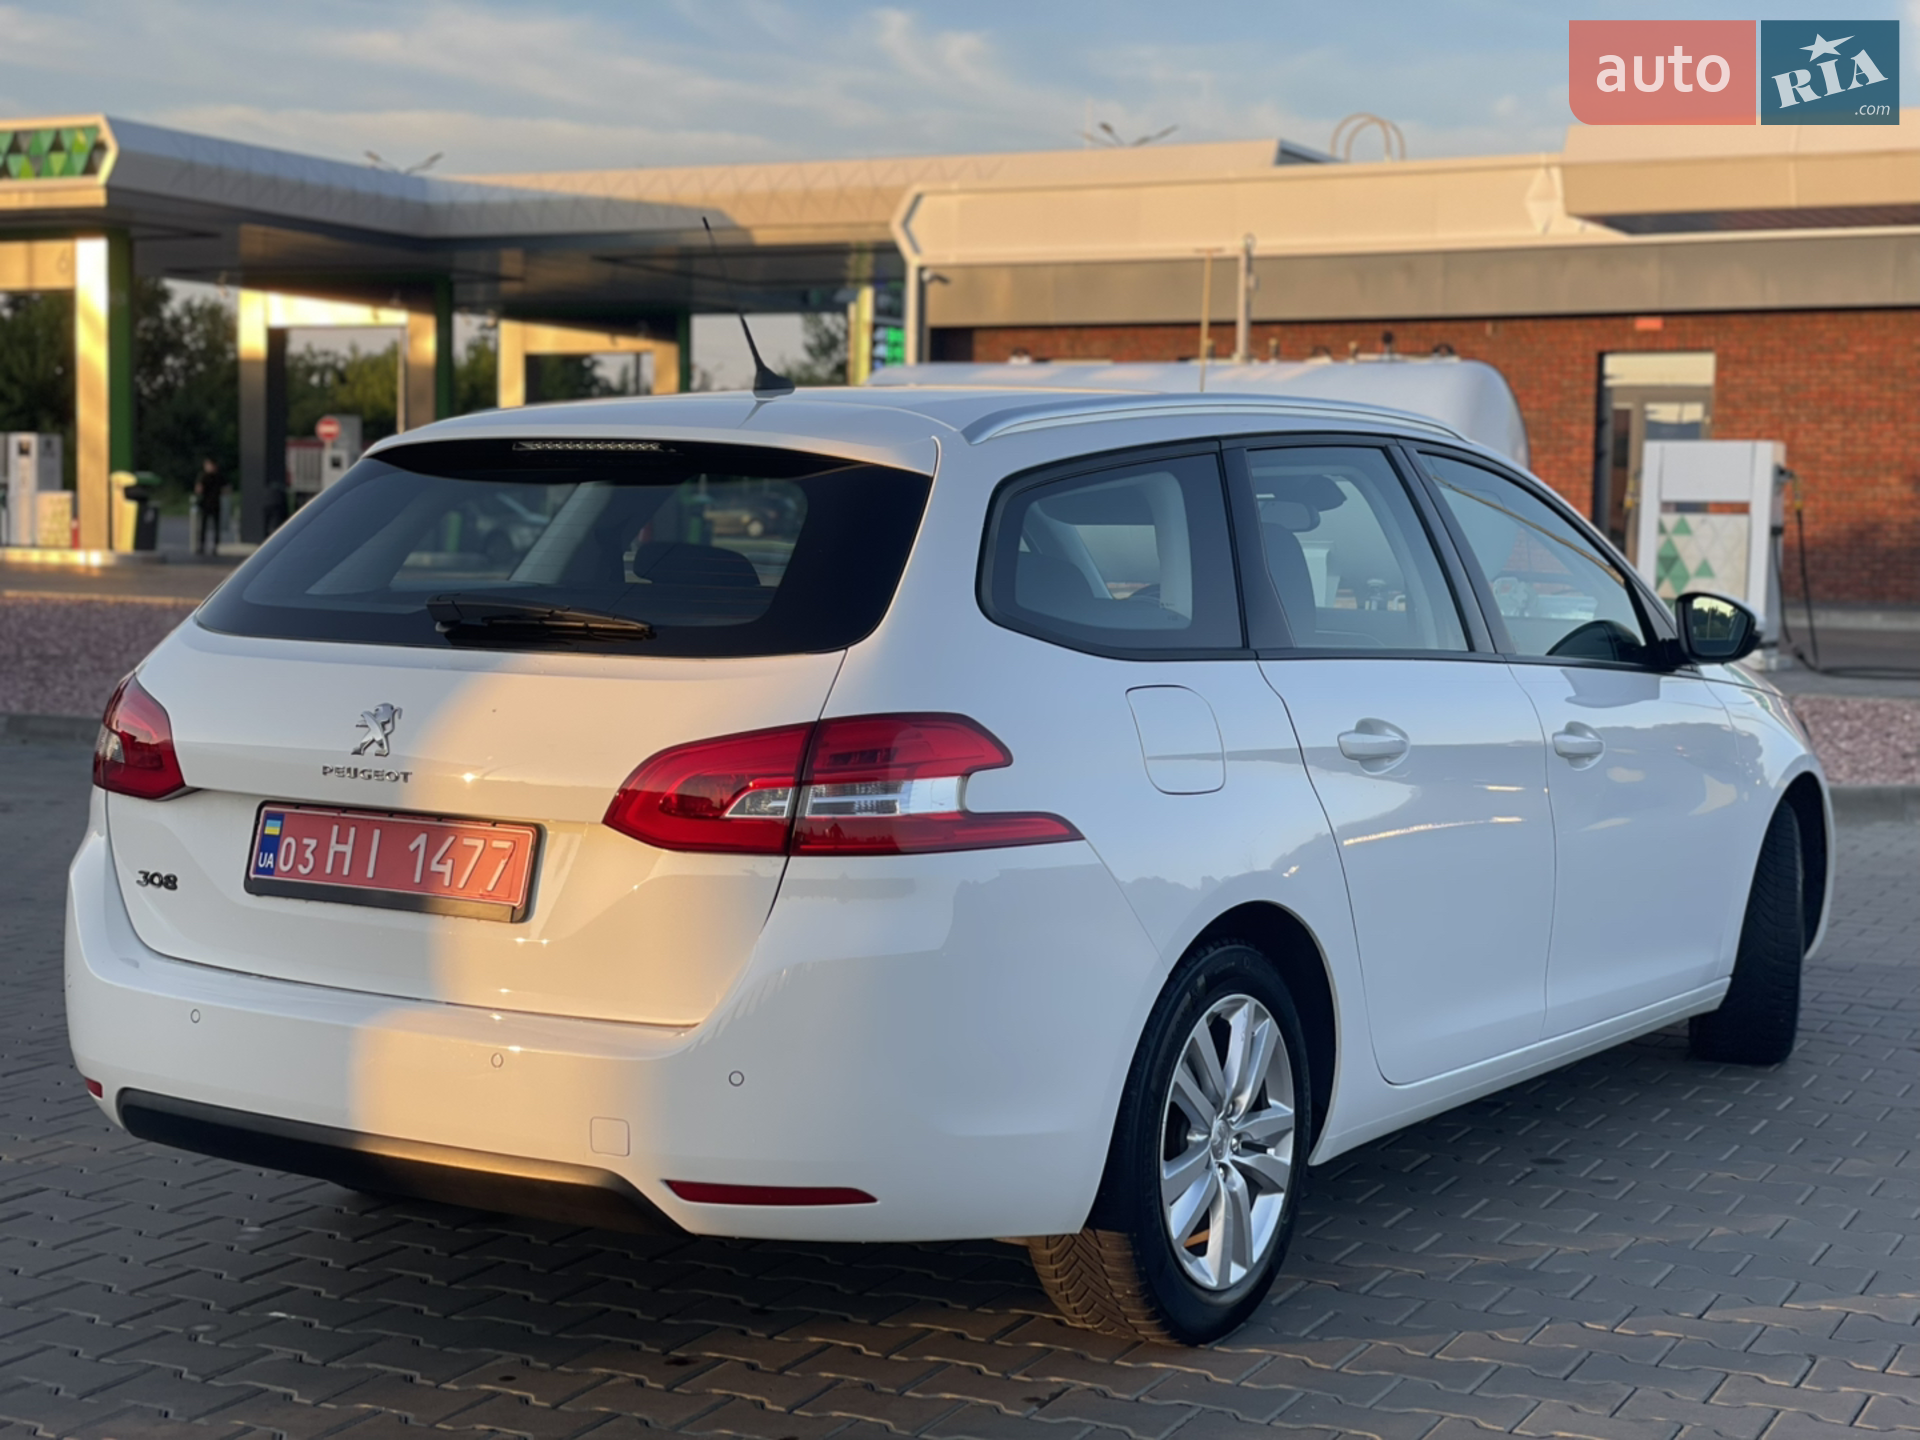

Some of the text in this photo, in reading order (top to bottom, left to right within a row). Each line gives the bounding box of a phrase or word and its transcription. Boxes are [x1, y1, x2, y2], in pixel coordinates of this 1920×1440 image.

[322, 765, 413, 783] PEUGEOT
[258, 851, 275, 870] UA
[278, 836, 318, 876] 03
[407, 832, 514, 892] 1477
[136, 869, 178, 891] 308
